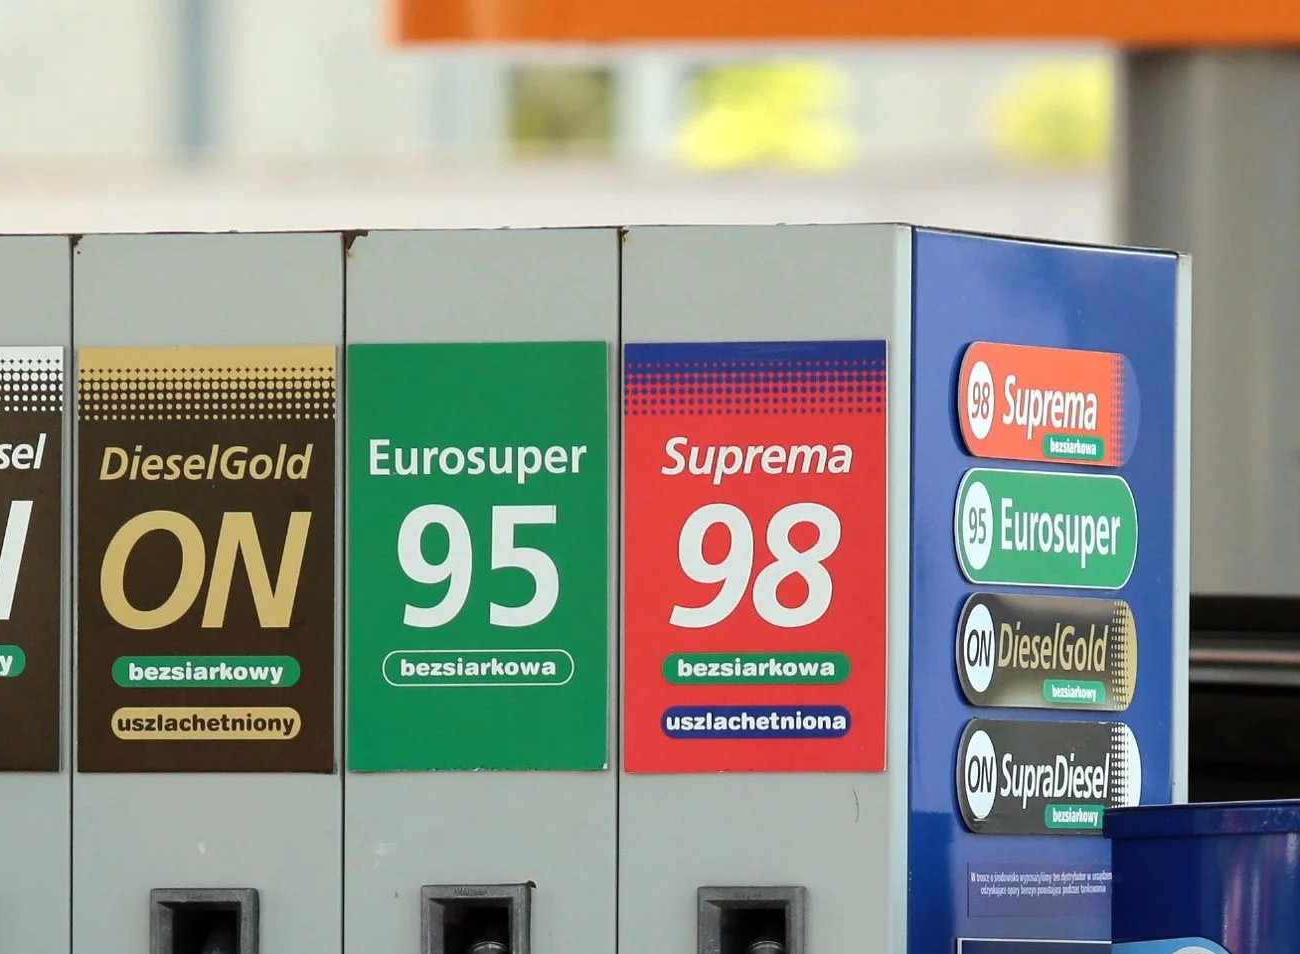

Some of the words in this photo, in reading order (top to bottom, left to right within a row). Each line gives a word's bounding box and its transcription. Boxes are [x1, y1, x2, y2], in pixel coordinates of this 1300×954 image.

[972, 381, 990, 420] 98
[1002, 374, 1098, 440] Suprema
[99, 444, 313, 480] DieselGold
[369, 439, 586, 484] Eurosuper
[661, 436, 853, 485] Suprema
[1050, 437, 1097, 456] bezsiarkowa
[969, 507, 986, 545] 95
[1001, 498, 1121, 568] Eurosuper
[100, 510, 312, 630] ON
[397, 504, 560, 628] 95
[668, 502, 842, 628] 98
[967, 629, 992, 667] ON
[998, 621, 1109, 672] DieselGold
[128, 662, 284, 684] bezsiarkowy
[401, 658, 556, 677] bezsiarkowa
[677, 658, 835, 678] bezsiarkowa
[1051, 684, 1097, 702] bezsiarkowy
[117, 714, 295, 736] uszlachetniony
[666, 712, 847, 731] uszlachetniona
[968, 755, 993, 793] ON
[1000, 753, 1110, 809] SupraDiesel
[1052, 808, 1098, 827] bezsiarkowy
